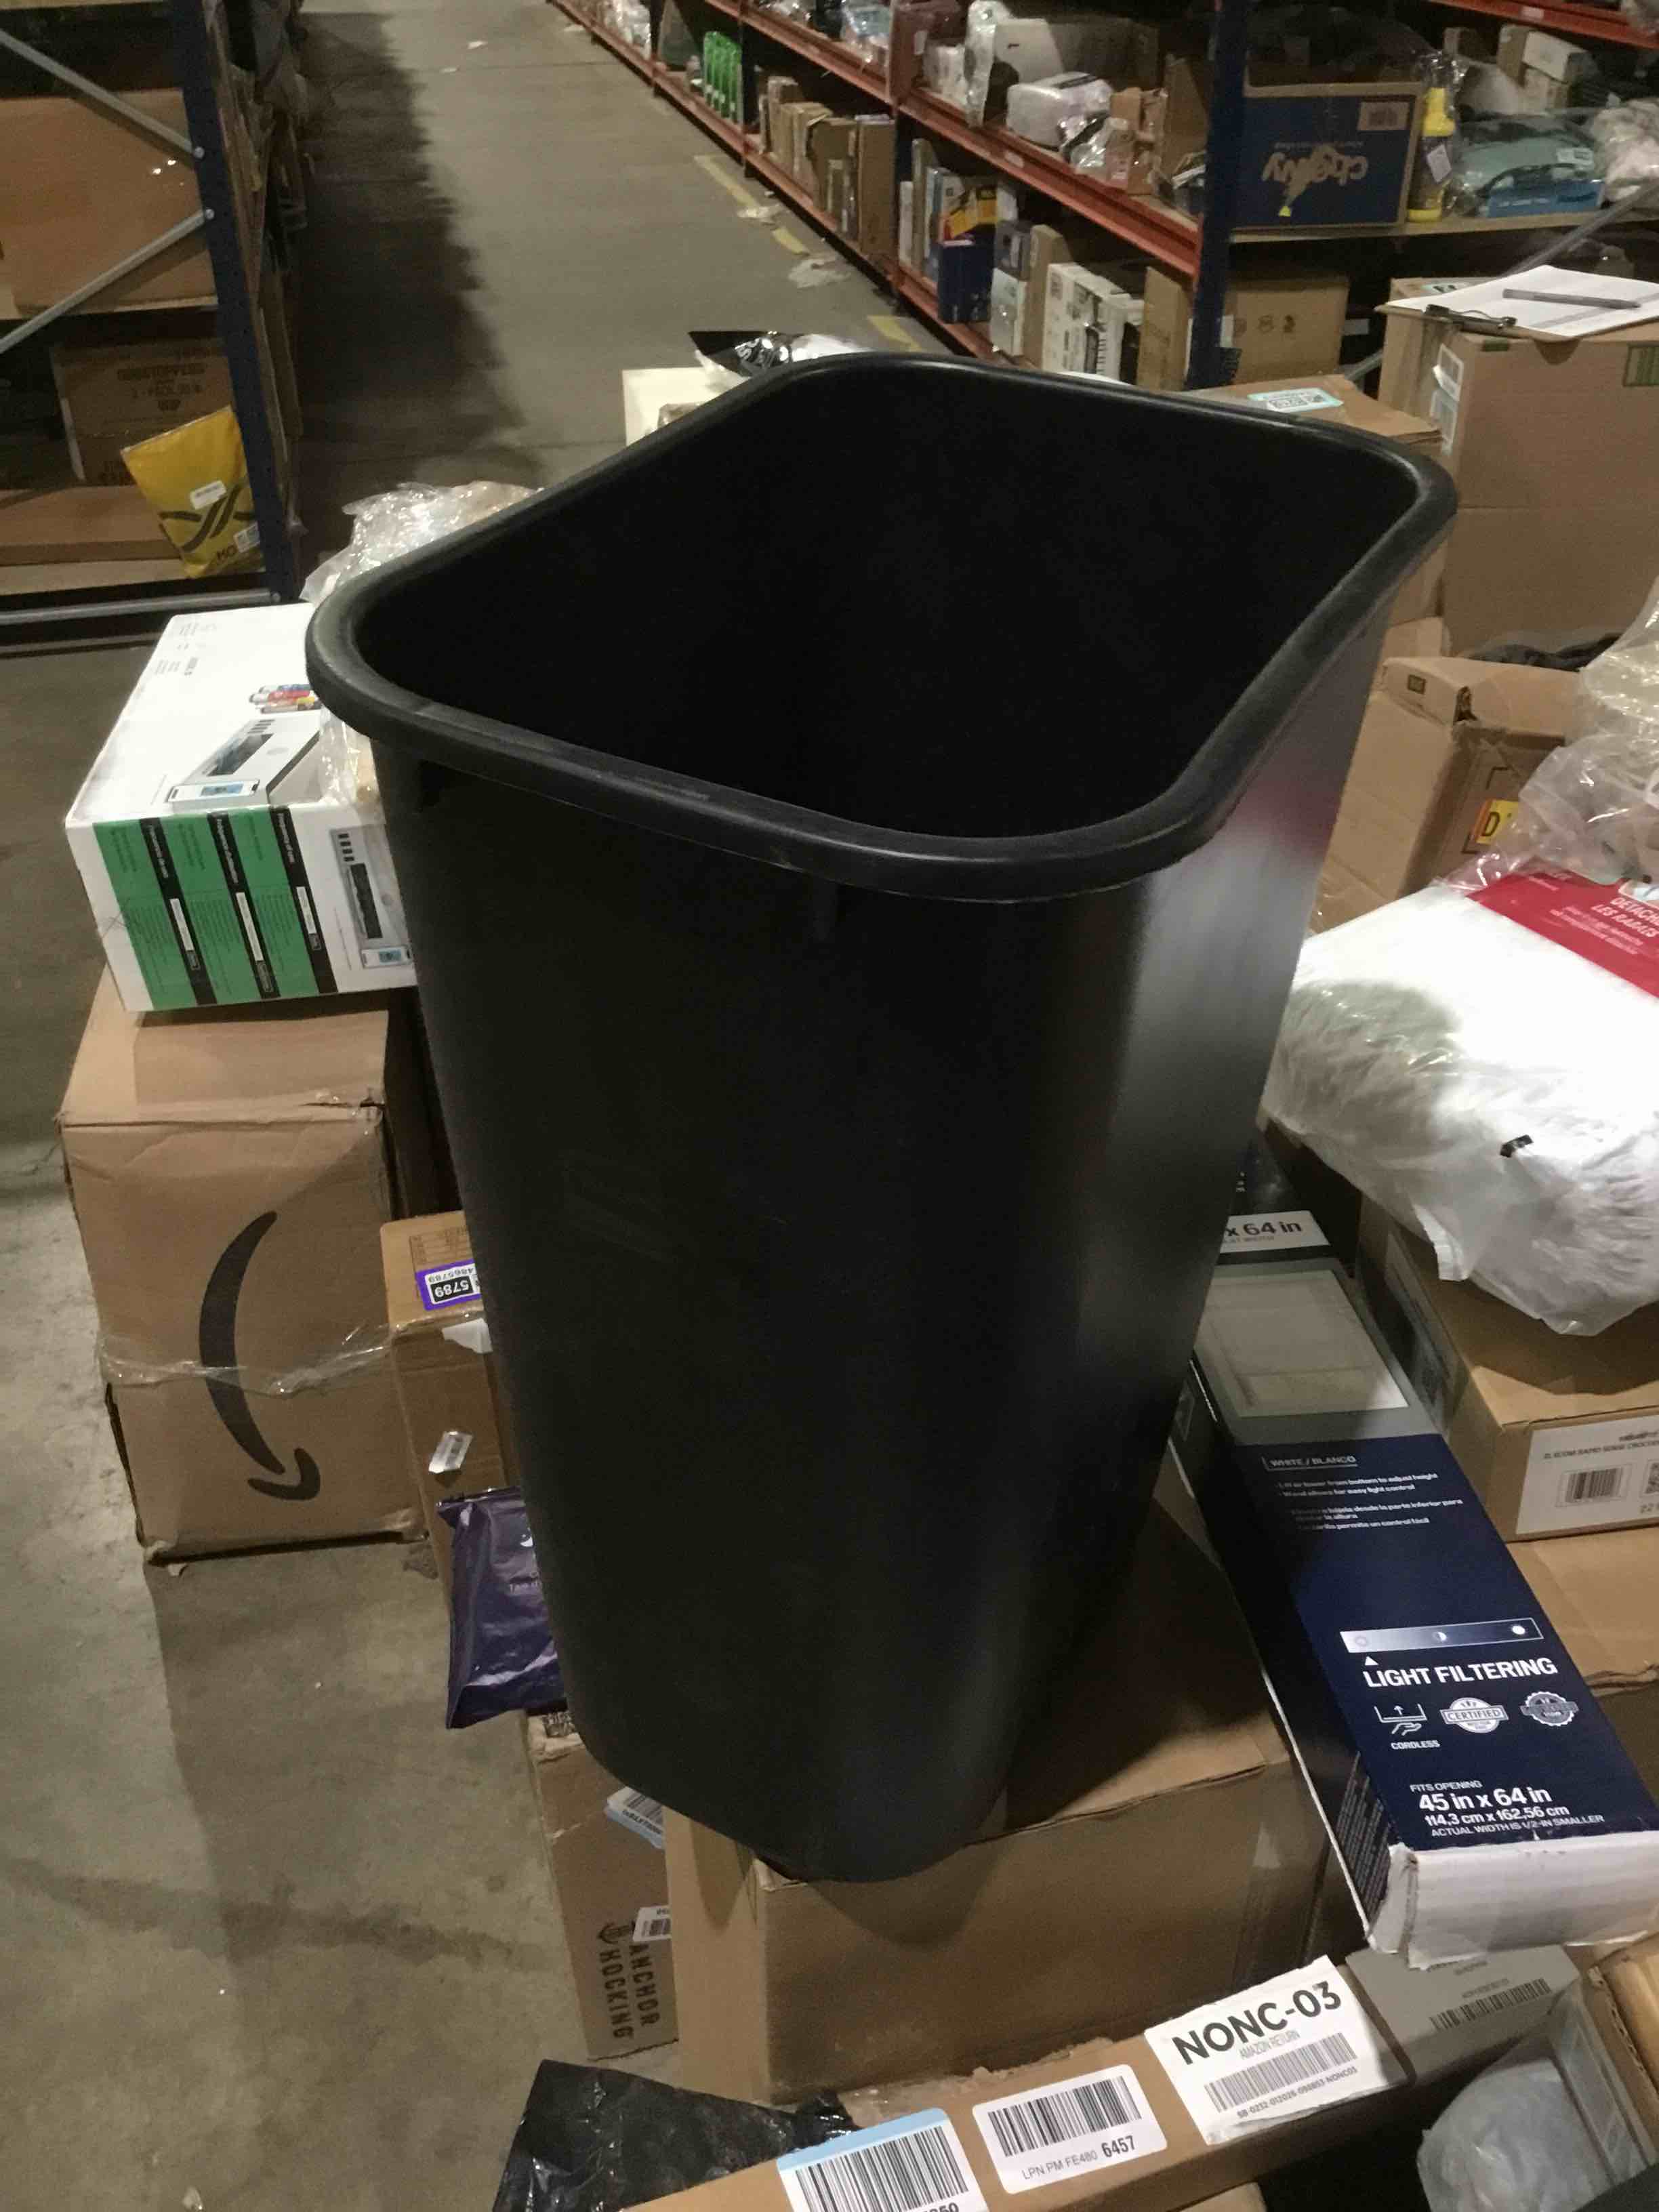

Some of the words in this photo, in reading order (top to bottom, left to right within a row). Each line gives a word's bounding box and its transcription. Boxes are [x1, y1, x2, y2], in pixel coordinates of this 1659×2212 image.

[1243, 1222, 1276, 1235] 64
[1279, 1221, 1302, 1232] in
[434, 1280, 469, 1297] 5789
[1269, 1458, 1302, 1467] WHITE
[1311, 1456, 1356, 1465] BLANCO
[1363, 1667, 1431, 1687] LIGHT
[1434, 1658, 1558, 1683] FILTERING
[1448, 1709, 1501, 1721] CERTIFIED
[1391, 1740, 1441, 1750] CORDLESS
[1410, 1784, 1434, 1793] FITS
[1435, 1780, 1483, 1791] OPENING
[1419, 1793, 1450, 1811] 45
[1450, 1793, 1475, 1809] in
[1476, 1795, 1493, 1807] x
[1493, 1787, 1527, 1806] 64
[1527, 1786, 1553, 1803] in
[1431, 1826, 1473, 1837] ACTUAL
[1474, 1823, 1509, 1834] WIDTH
[1509, 1822, 1521, 1830] IS
[1553, 1814, 1605, 1826] SMALLER
[1462, 1813, 1485, 1824] cm
[1485, 1812, 1496, 1822] x
[1546, 1805, 1570, 1816] cm
[599, 1949, 634, 2039] HOCKING
[628, 1944, 661, 2027] ANCHOR
[1172, 1981, 1341, 2066] NONC-03
[1240, 2038, 1272, 2060] AMAZON
[1269, 2029, 1301, 2050] RETURN
[1022, 2165, 1046, 2180] LPN
[1046, 2161, 1065, 2173] PM
[1101, 2135, 1136, 2158] 6457
